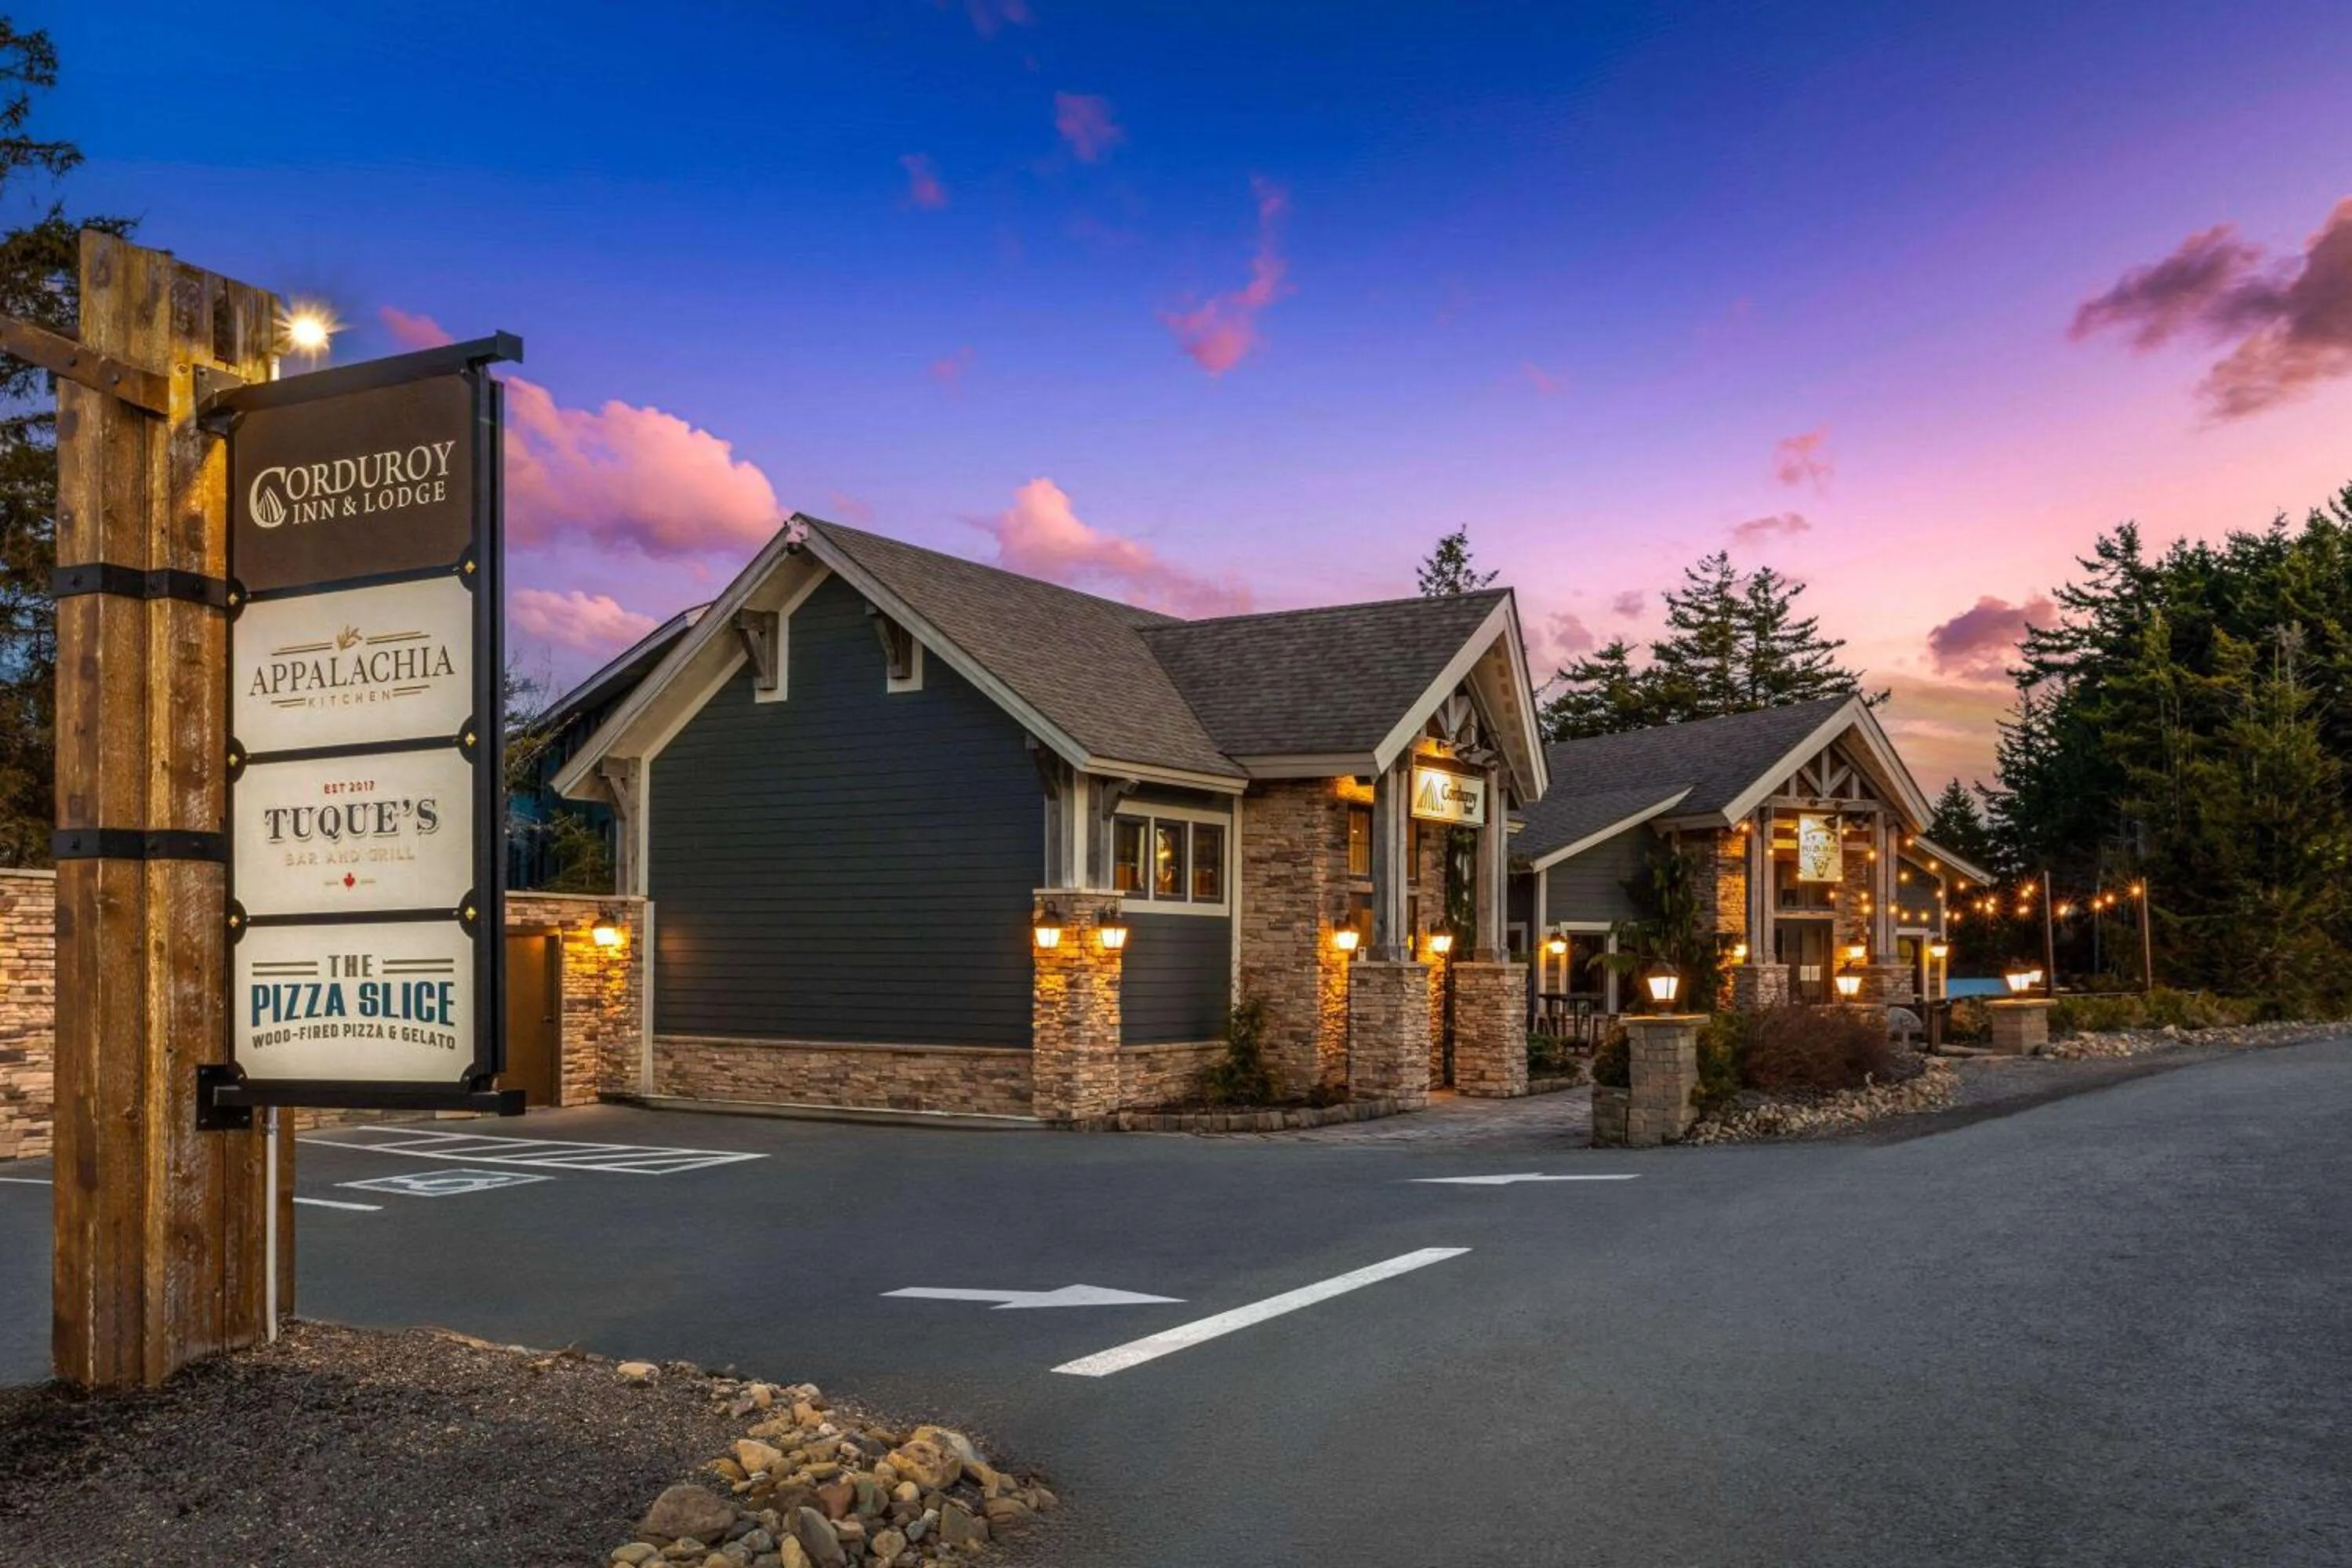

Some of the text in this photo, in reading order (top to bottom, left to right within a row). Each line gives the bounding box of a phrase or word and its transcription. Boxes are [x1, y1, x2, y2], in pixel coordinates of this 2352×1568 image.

[249, 440, 456, 529] CORDUROY
[292, 481, 446, 524] INN & LODGE
[249, 644, 456, 696] APPALACHIA
[308, 689, 391, 707] KITCHEN
[323, 780, 376, 795] EST 2017
[264, 798, 440, 844] TUQUE'S
[286, 847, 416, 866] BAR AND GRILL
[328, 954, 373, 978] THE
[252, 981, 456, 1028] PIZZA SLICE
[252, 1022, 456, 1051] WOOD-FIRED PIZZA & GELATO
